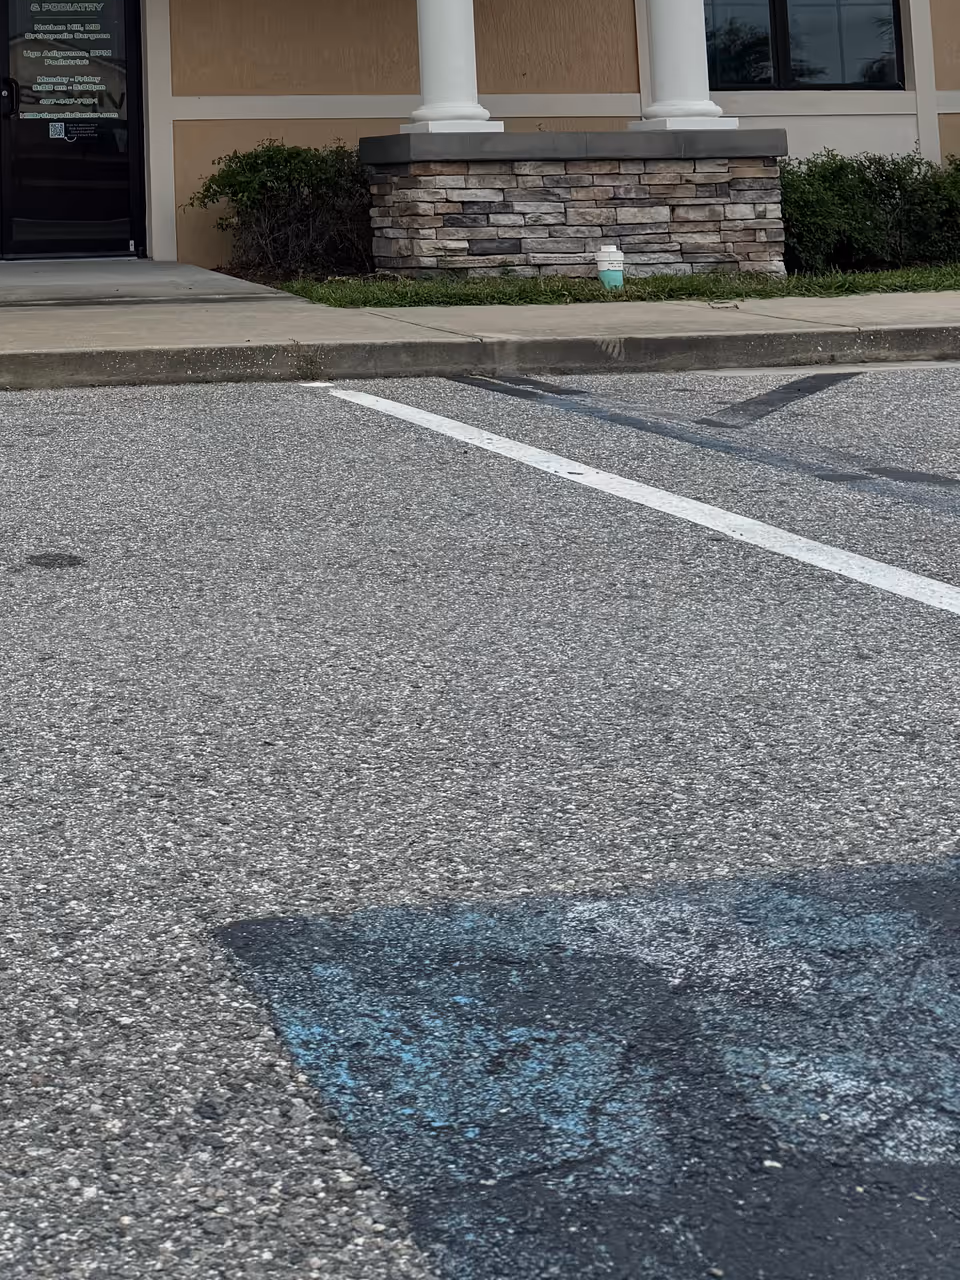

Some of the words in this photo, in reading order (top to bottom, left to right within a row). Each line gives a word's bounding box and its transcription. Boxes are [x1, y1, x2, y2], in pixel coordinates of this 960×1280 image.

[30, 3, 40, 11] &
[42, 3, 104, 11] PODIATRY
[37, 76, 69, 84] Monday
